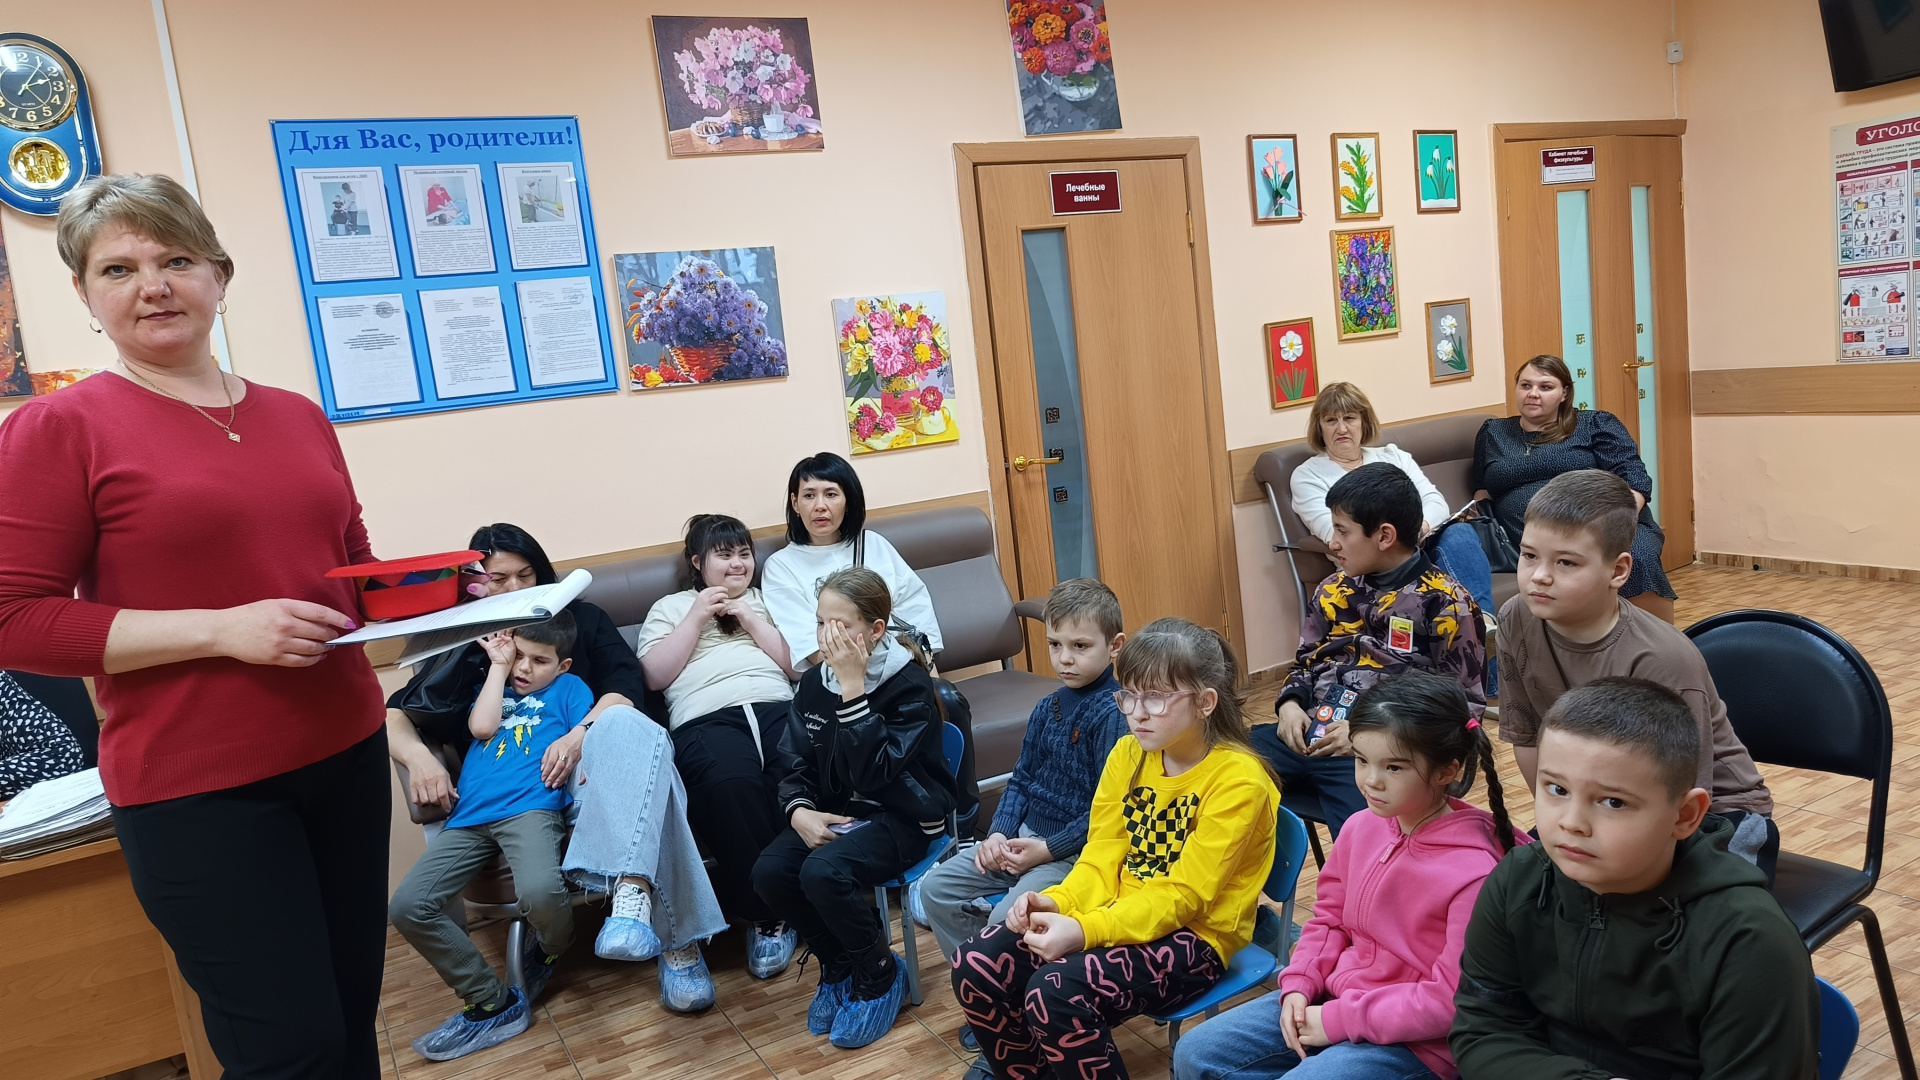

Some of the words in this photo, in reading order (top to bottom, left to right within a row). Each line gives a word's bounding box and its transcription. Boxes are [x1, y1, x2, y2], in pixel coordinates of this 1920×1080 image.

[12, 52, 29, 63] 12
[47, 66, 59, 77] 2
[52, 81, 65, 92] 3
[50, 94, 62, 105] 4
[8, 107, 19, 119] 7
[26, 110, 37, 122] 6
[42, 106, 53, 117] 5
[289, 130, 351, 155] Для
[356, 128, 422, 152] Вас,
[427, 126, 575, 153] родители!
[1065, 182, 1106, 193] Лечебные
[1073, 194, 1100, 203] ванны
